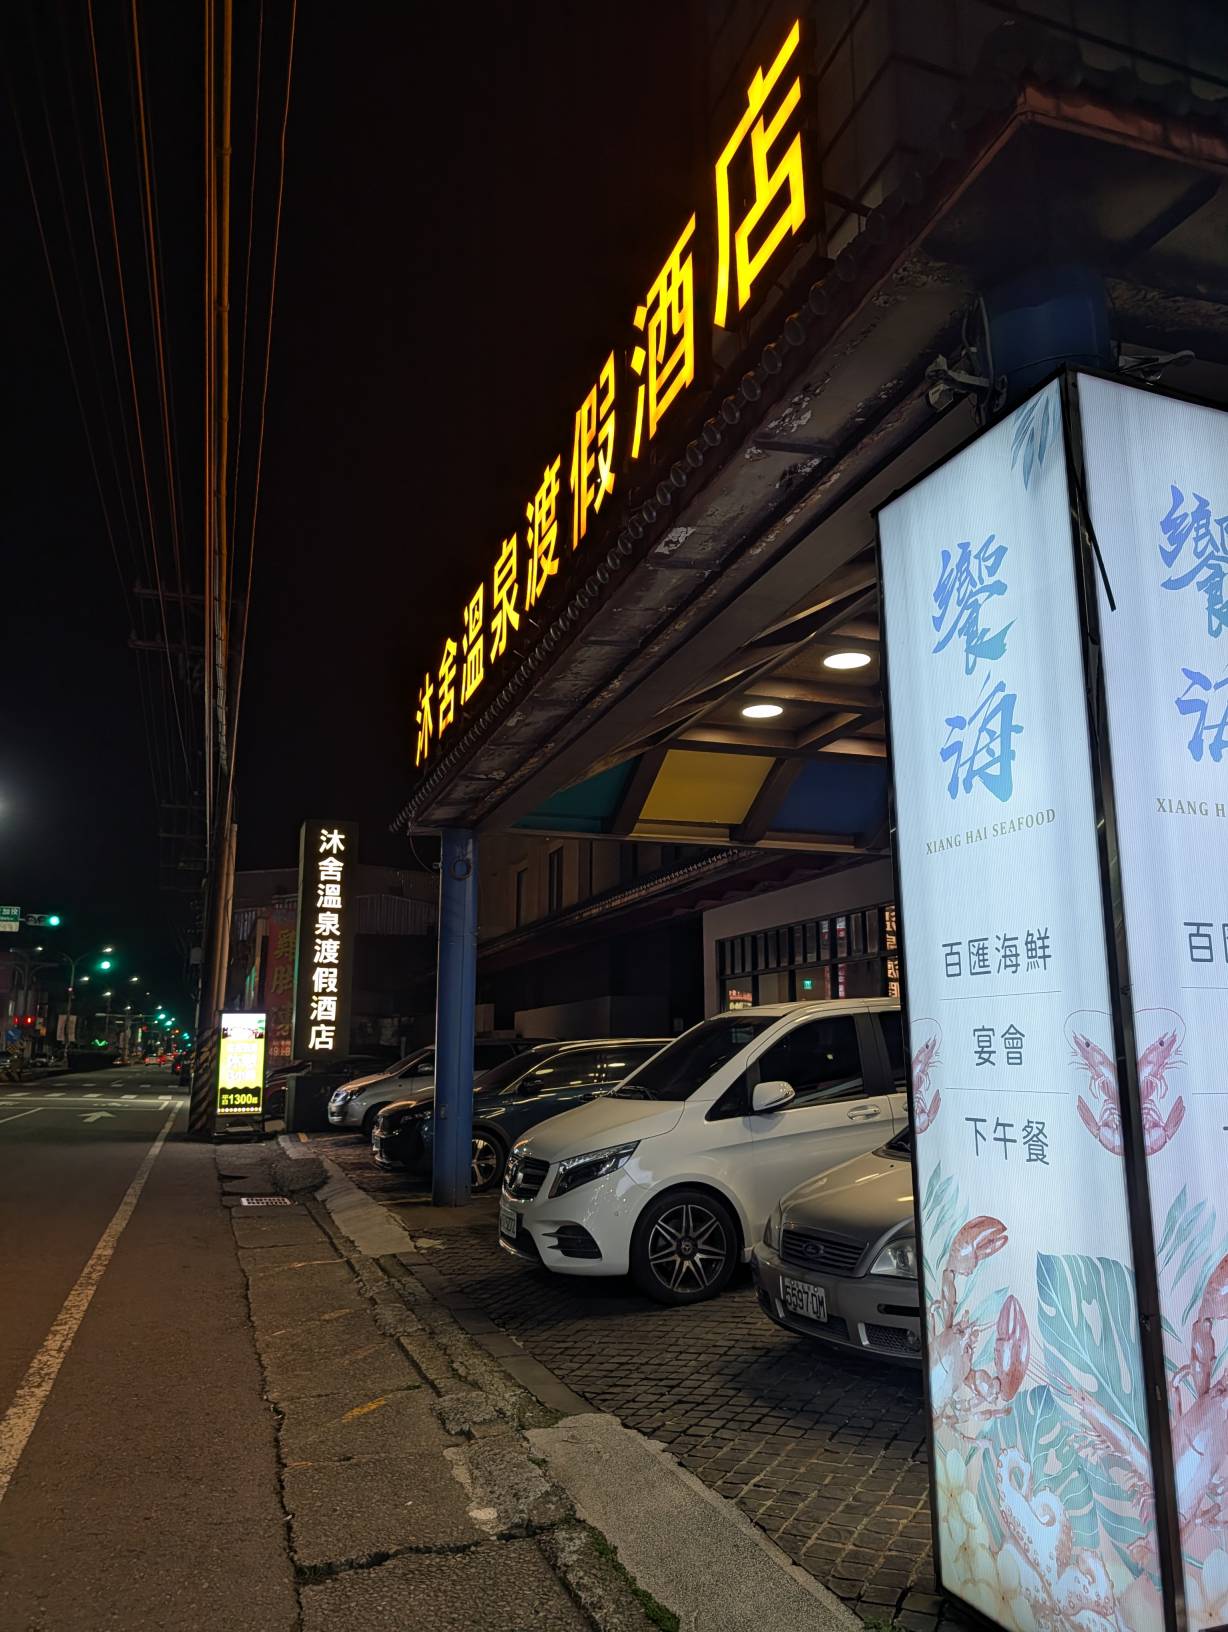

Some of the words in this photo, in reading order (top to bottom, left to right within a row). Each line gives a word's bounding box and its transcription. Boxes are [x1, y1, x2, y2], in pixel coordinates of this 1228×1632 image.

[416, 18, 806, 767] 沐舍溫泉渡假酒店
[931, 533, 1023, 802] 饗海
[926, 834, 962, 855] XIANG
[966, 816, 988, 845] HAI
[992, 808, 1056, 838] SEAFOOD
[1156, 797, 1210, 817] XIANG
[308, 828, 346, 1050] 沐舍溫泉渡假酒店
[942, 927, 1052, 978] 百匯海鮮
[973, 1023, 1026, 1067] 宴會
[964, 1116, 1050, 1166] 下午餐
